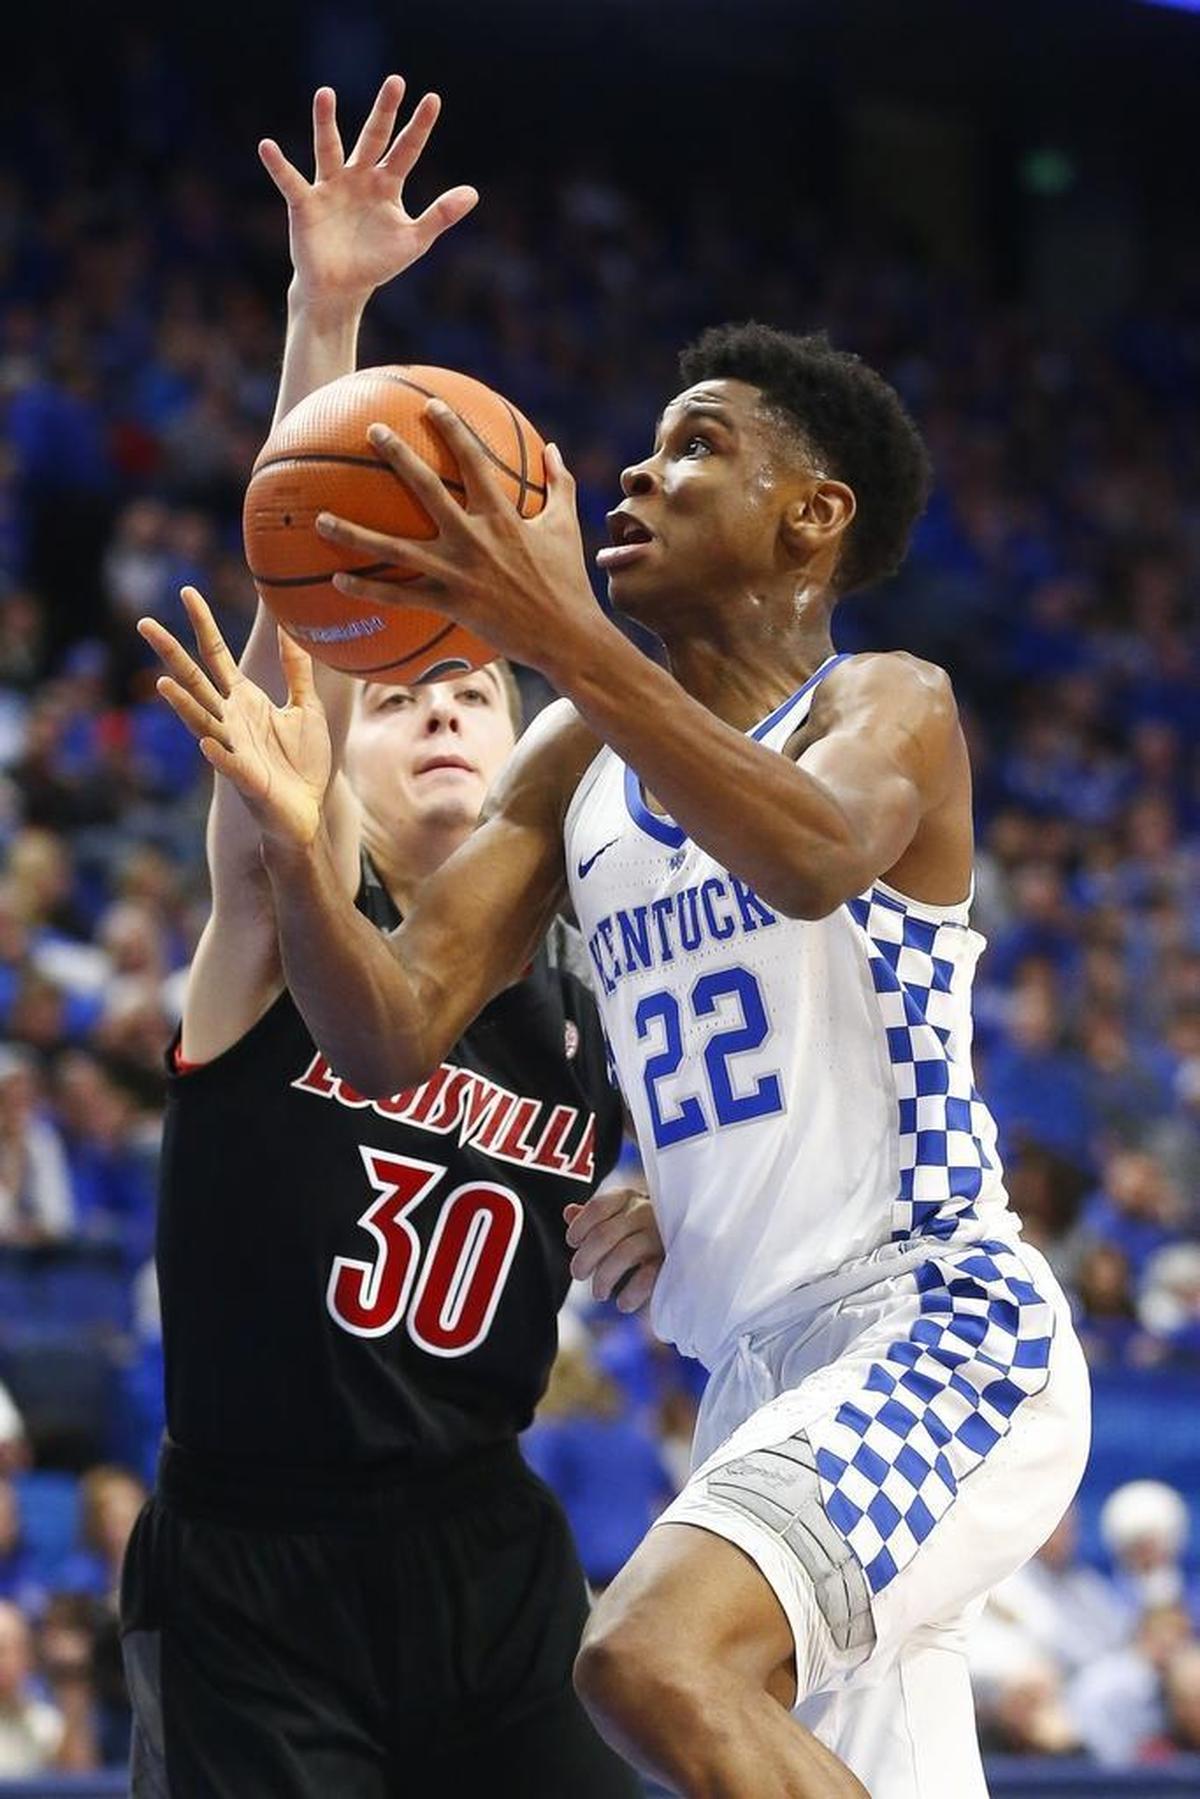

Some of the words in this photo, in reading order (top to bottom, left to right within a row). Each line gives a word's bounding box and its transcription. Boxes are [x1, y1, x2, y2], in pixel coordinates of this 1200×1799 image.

[588, 873, 778, 996] KENTUCK
[634, 964, 784, 1150] 22
[327, 1145, 524, 1358] 30
